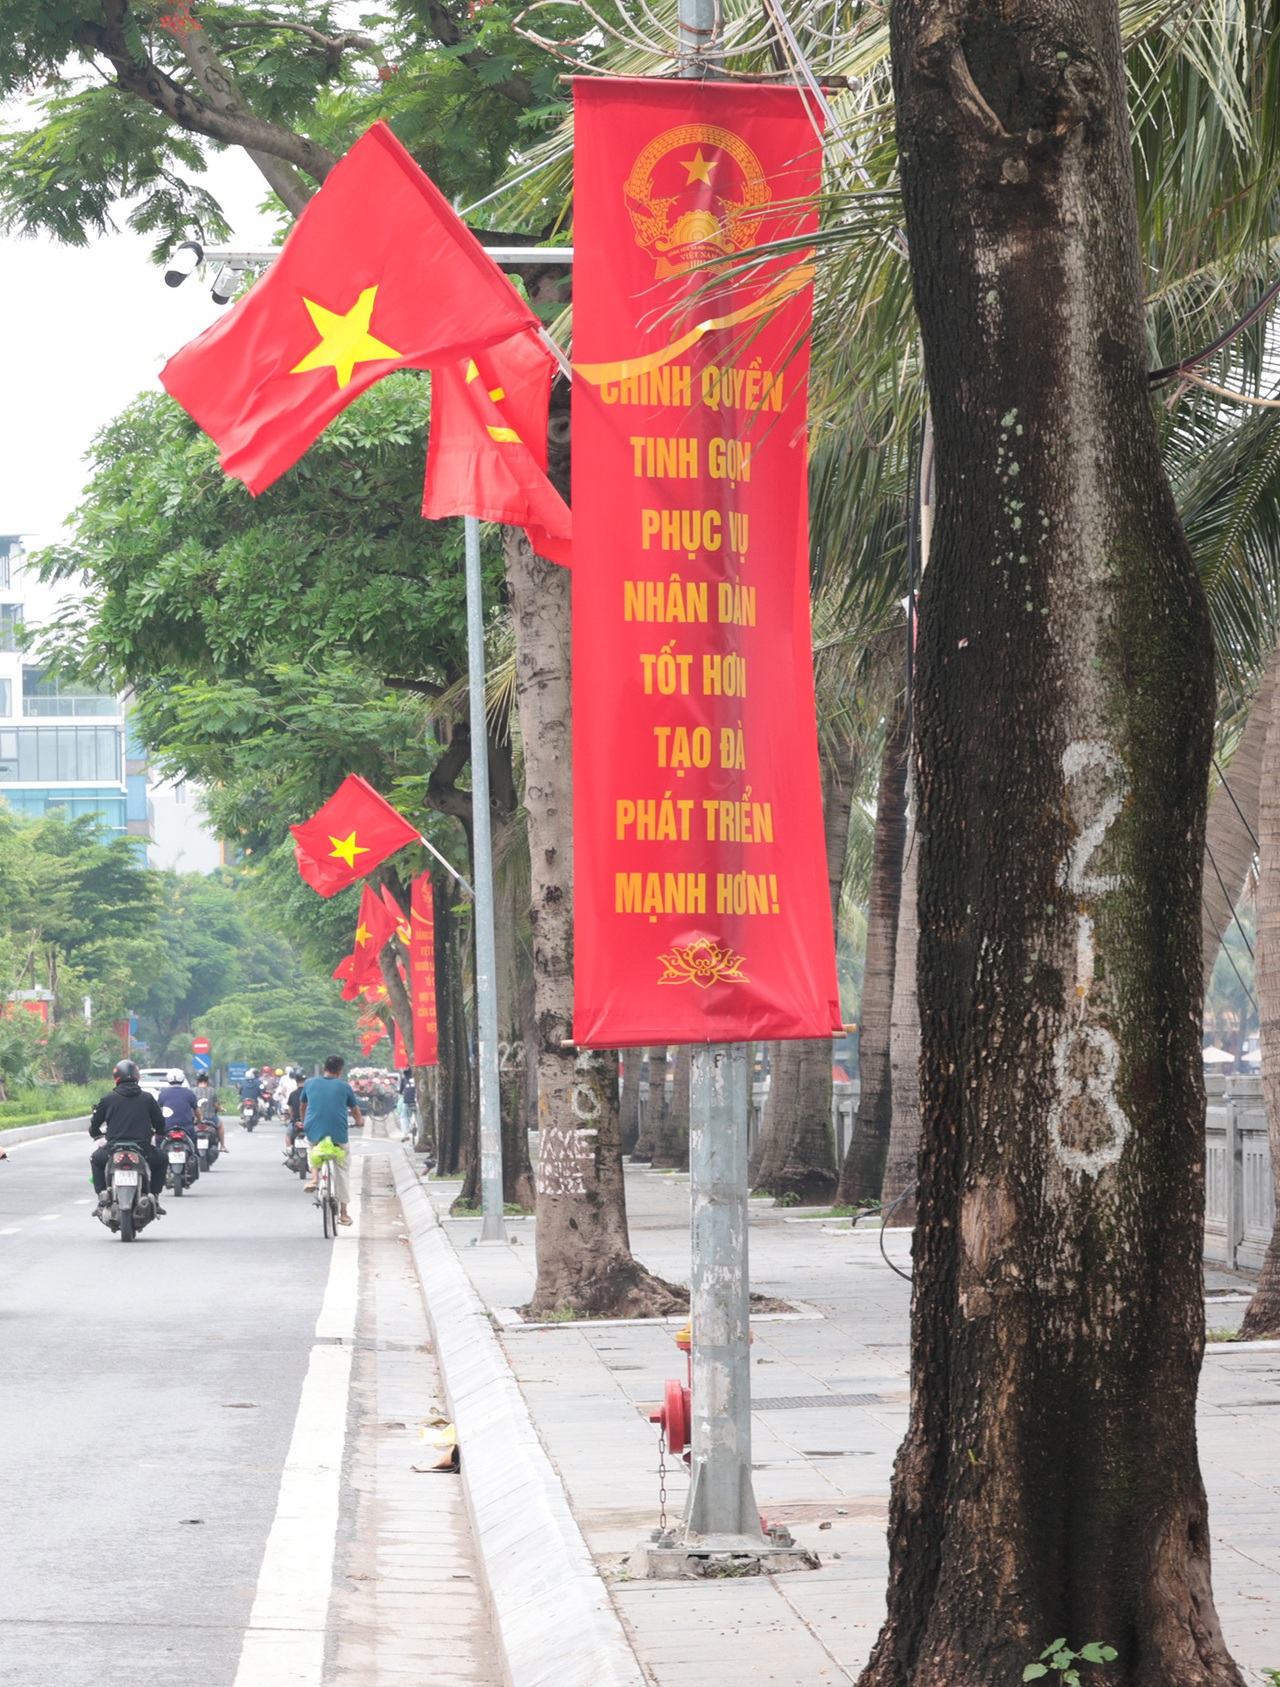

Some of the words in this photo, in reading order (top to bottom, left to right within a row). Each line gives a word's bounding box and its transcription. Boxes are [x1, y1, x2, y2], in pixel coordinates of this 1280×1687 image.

[702, 356, 784, 412] QUYỀN
[630, 436, 698, 478] TINH
[708, 437, 752, 490] GỌN
[642, 509, 722, 560] PHỤC
[728, 511, 749, 563] VỤ
[624, 573, 708, 623] NHÂN
[718, 575, 757, 627] DÂN
[639, 640, 694, 695] TỐT
[702, 652, 747, 698] HƠN
[654, 726, 712, 777] TẠO
[720, 720, 746, 770] ĐÀ
[616, 789, 694, 841] PHÁT
[702, 785, 774, 843] TRIỂN
[615, 872, 707, 923] MẠNH
[717, 870, 780, 915] HƠN!
